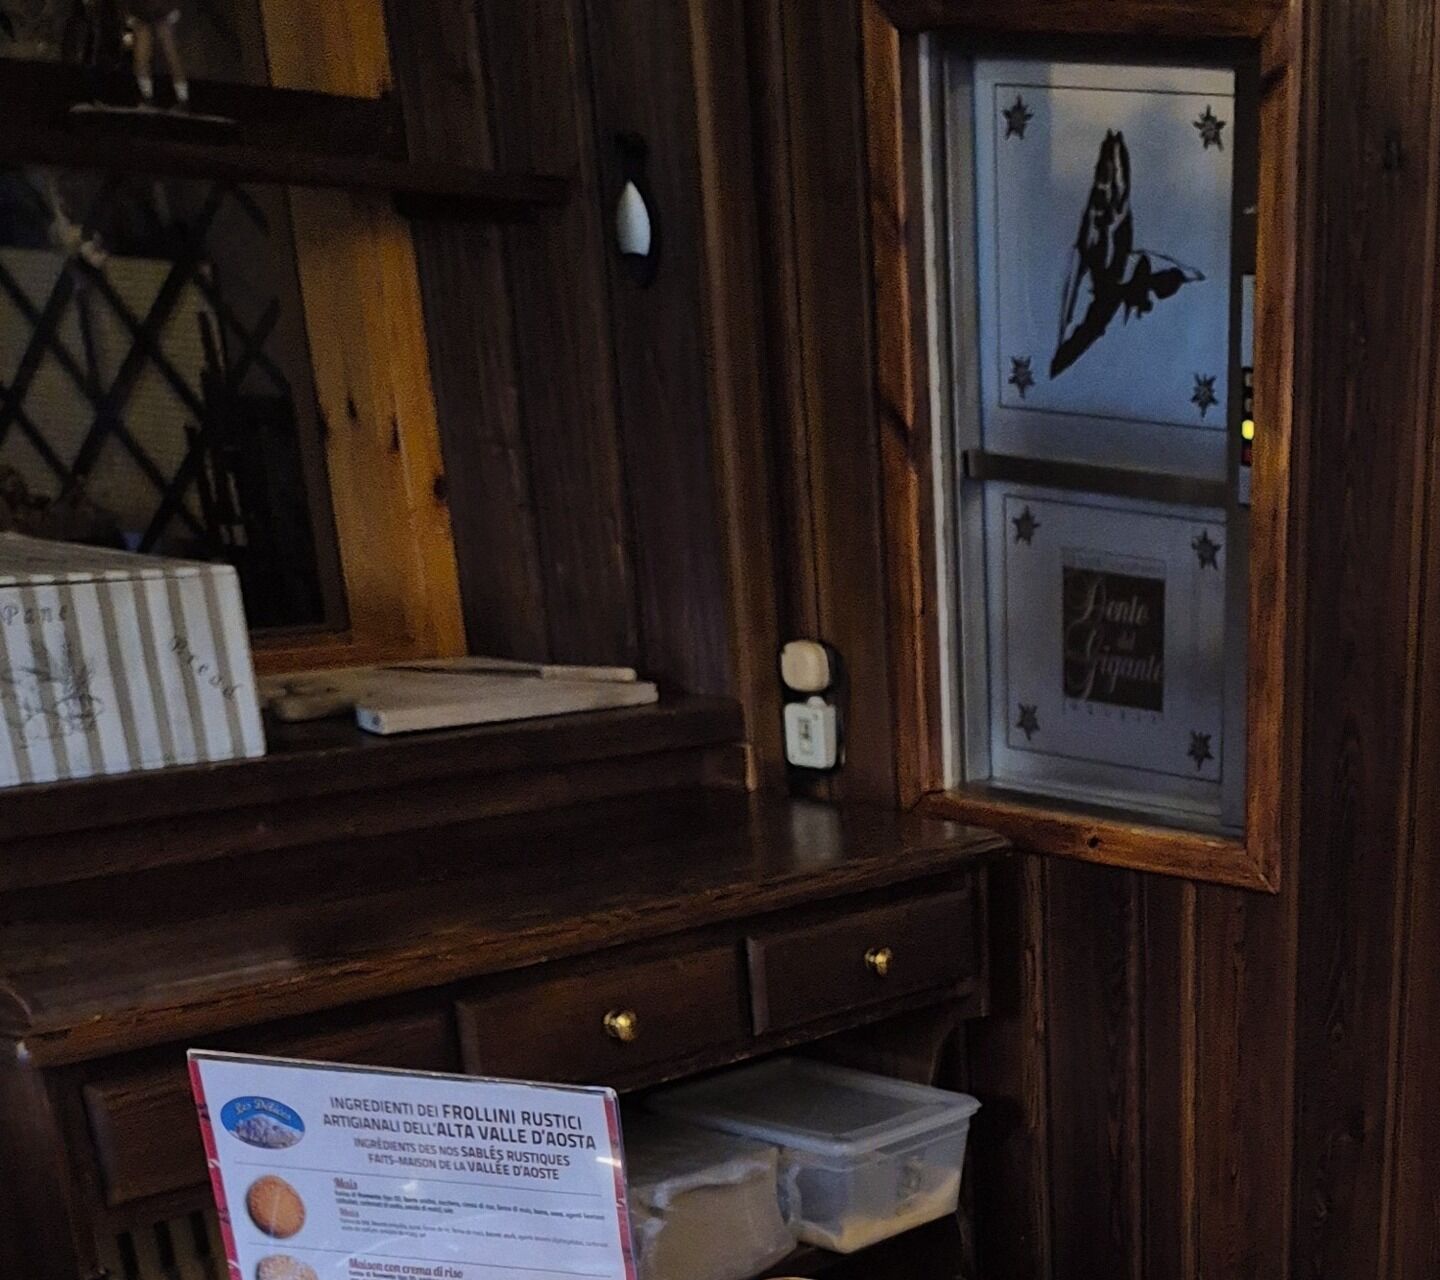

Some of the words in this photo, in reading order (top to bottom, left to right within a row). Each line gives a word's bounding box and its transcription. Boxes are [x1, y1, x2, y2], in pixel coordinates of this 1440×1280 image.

[330, 1097, 413, 1116] INGREDIENTI
[417, 1104, 438, 1117] DEI
[442, 1104, 515, 1125] FROLLINI
[521, 1111, 582, 1131] RUSTICI
[324, 1114, 400, 1133] ARTIGIANALI
[403, 1121, 474, 1139] DELL'ALTA
[478, 1126, 527, 1144] VALLE
[532, 1129, 596, 1150] D'AOSTA
[440, 1160, 452, 1170] DE
[454, 1161, 466, 1170] LA
[467, 1159, 509, 1176] VALLÉE
[513, 1165, 559, 1180] D'AOSTE
[461, 1145, 504, 1161] SABLÉS
[506, 1150, 570, 1167] RUSTIQUES
